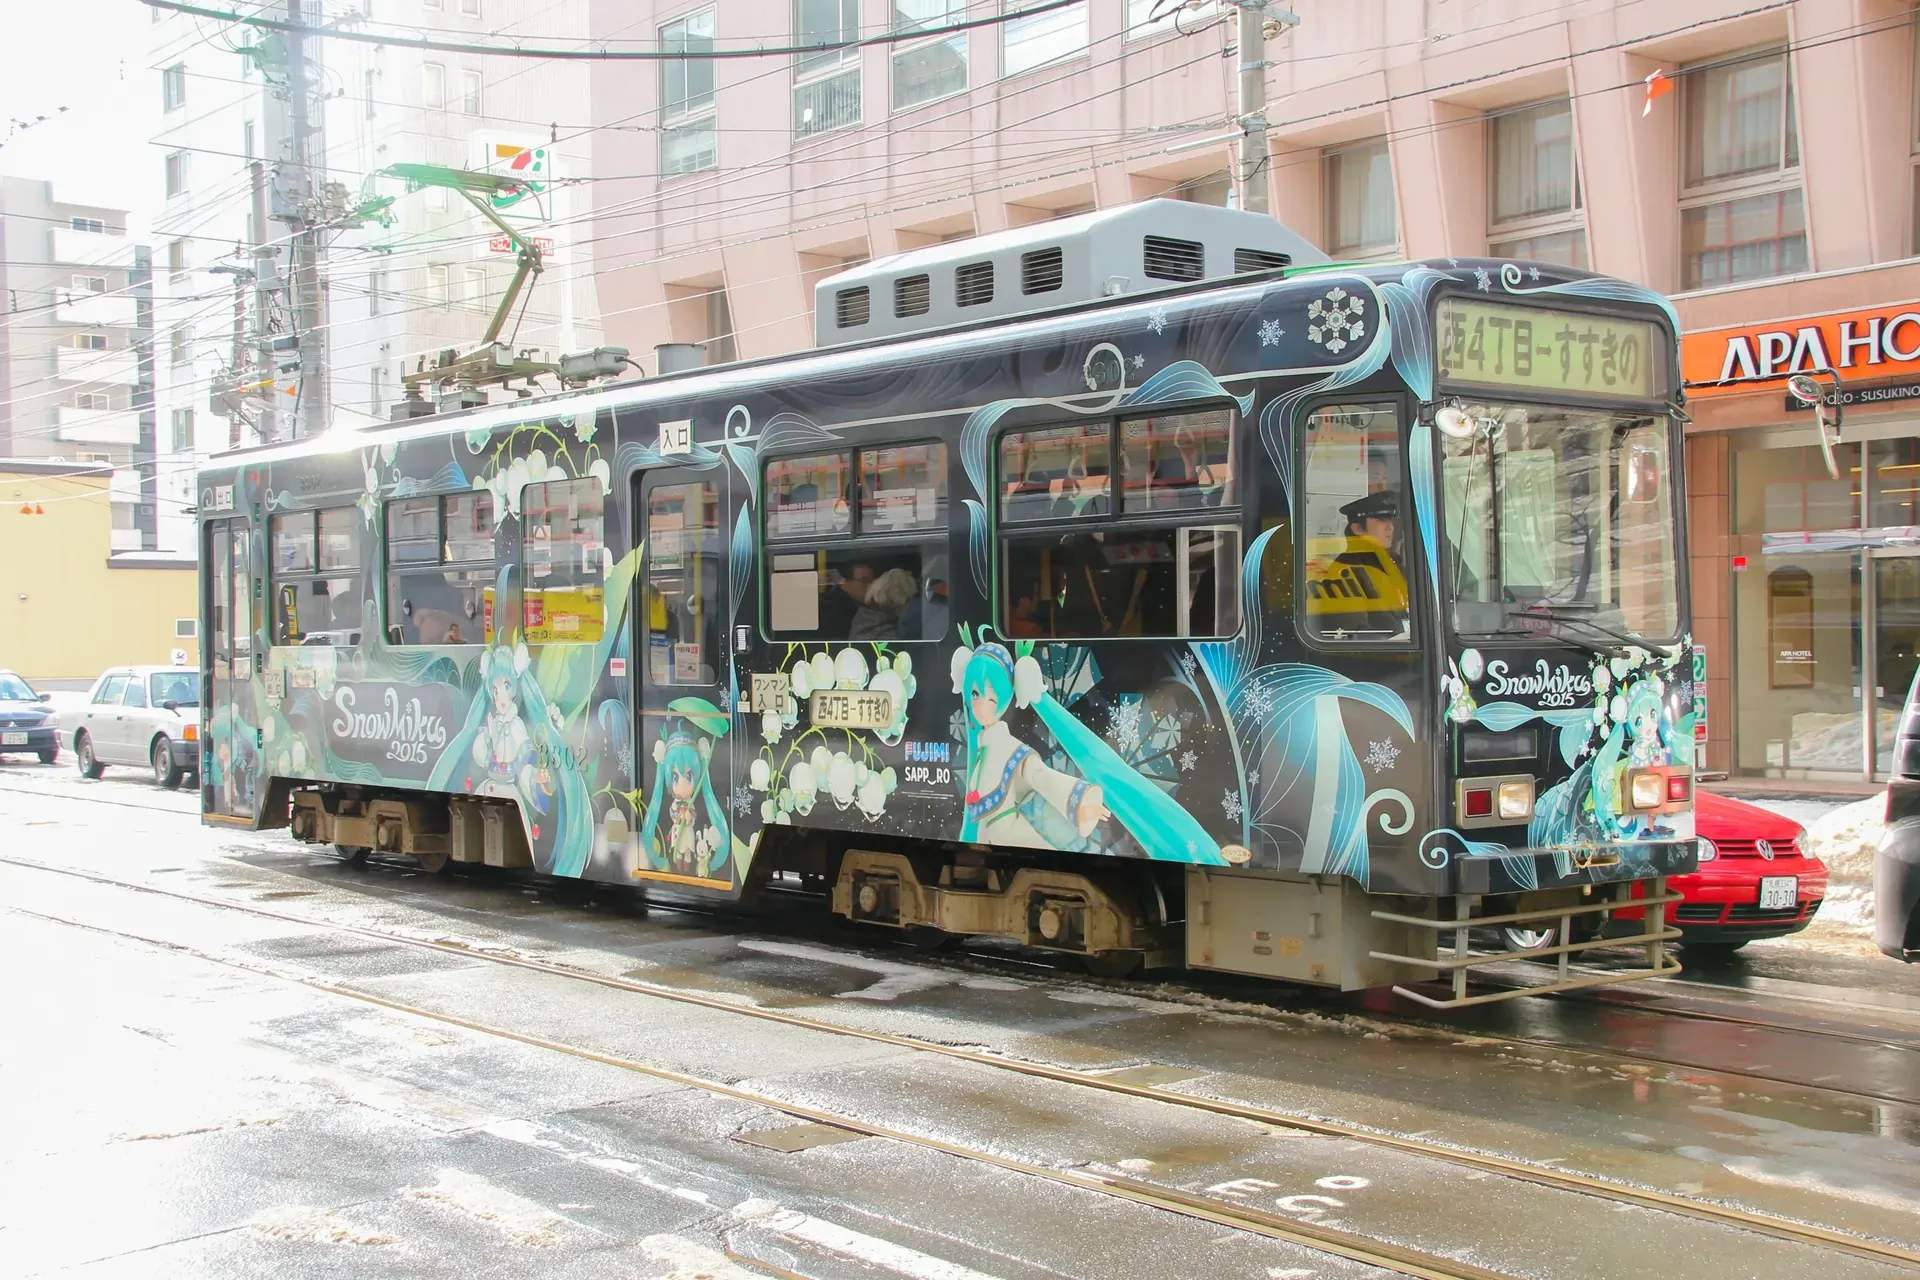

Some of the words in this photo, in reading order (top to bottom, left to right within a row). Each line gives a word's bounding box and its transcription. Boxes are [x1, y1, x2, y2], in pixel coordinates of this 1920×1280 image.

[1719, 325, 1834, 383] APA
[663, 427, 688, 449] 入口
[754, 678, 787, 691] ワンマン
[757, 693, 784, 709] 入口
[1538, 691, 1575, 707] 2015
[386, 740, 428, 764] 2015
[905, 741, 950, 763] FUJIMI
[1766, 890, 1794, 906] 30-30
